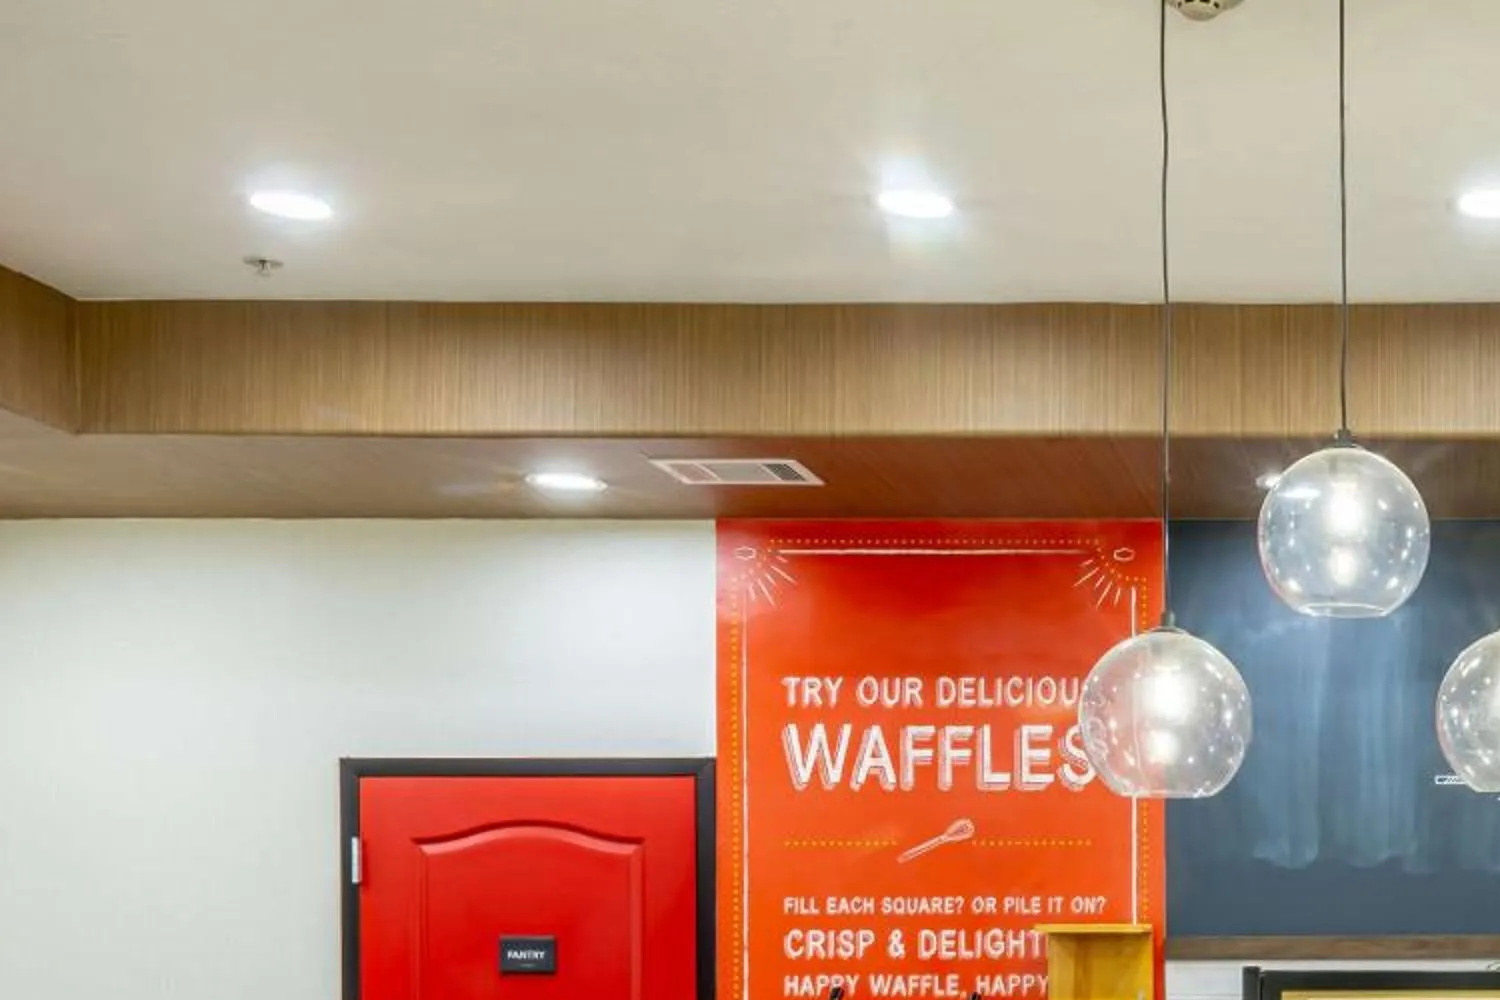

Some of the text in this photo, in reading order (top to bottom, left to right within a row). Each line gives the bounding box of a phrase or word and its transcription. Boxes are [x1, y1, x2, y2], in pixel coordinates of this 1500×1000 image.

[782, 676, 1082, 706] TRY OUR DELICIOU
[781, 723, 1098, 791] WAFFLES
[784, 896, 1107, 914] FILL EACH SQUARE? OR PILE IT ON?
[507, 950, 545, 960] PANTRY
[784, 928, 1049, 960] CRISP & DELIGHT
[783, 974, 1049, 1000] HAPPY WAFFLE, HAPPY
